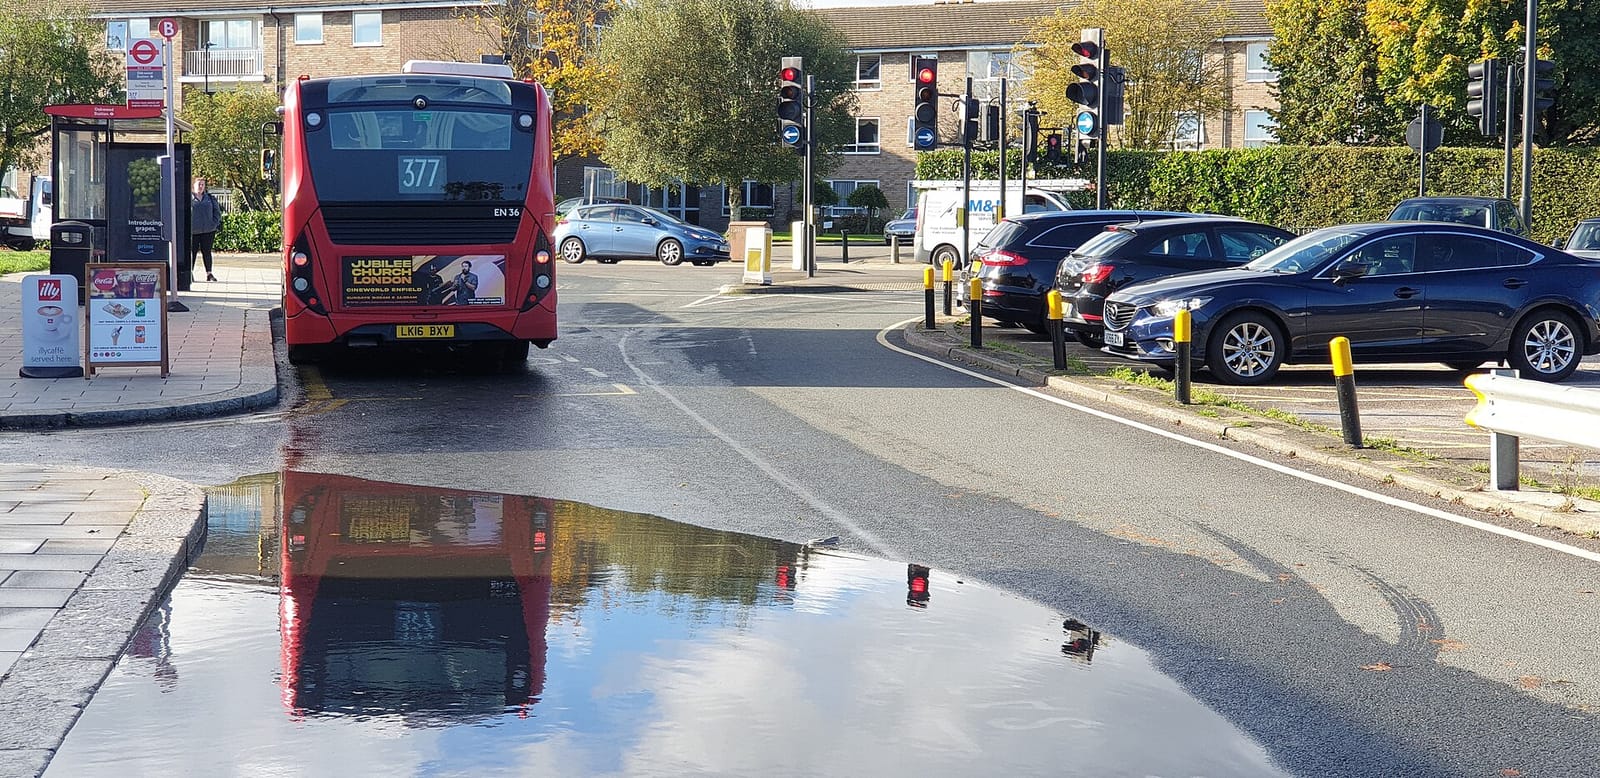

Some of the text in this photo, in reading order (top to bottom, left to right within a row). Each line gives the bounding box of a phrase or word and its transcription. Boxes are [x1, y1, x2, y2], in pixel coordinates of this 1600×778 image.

[164, 22, 175, 36] B
[403, 159, 440, 187] 377
[494, 208, 520, 217] EN 36
[351, 260, 412, 268] JUBILEE
[351, 268, 412, 276] CHURCH
[353, 276, 412, 284] LONDON
[40, 283, 60, 299] illy
[401, 326, 449, 336] LK16 BXY
